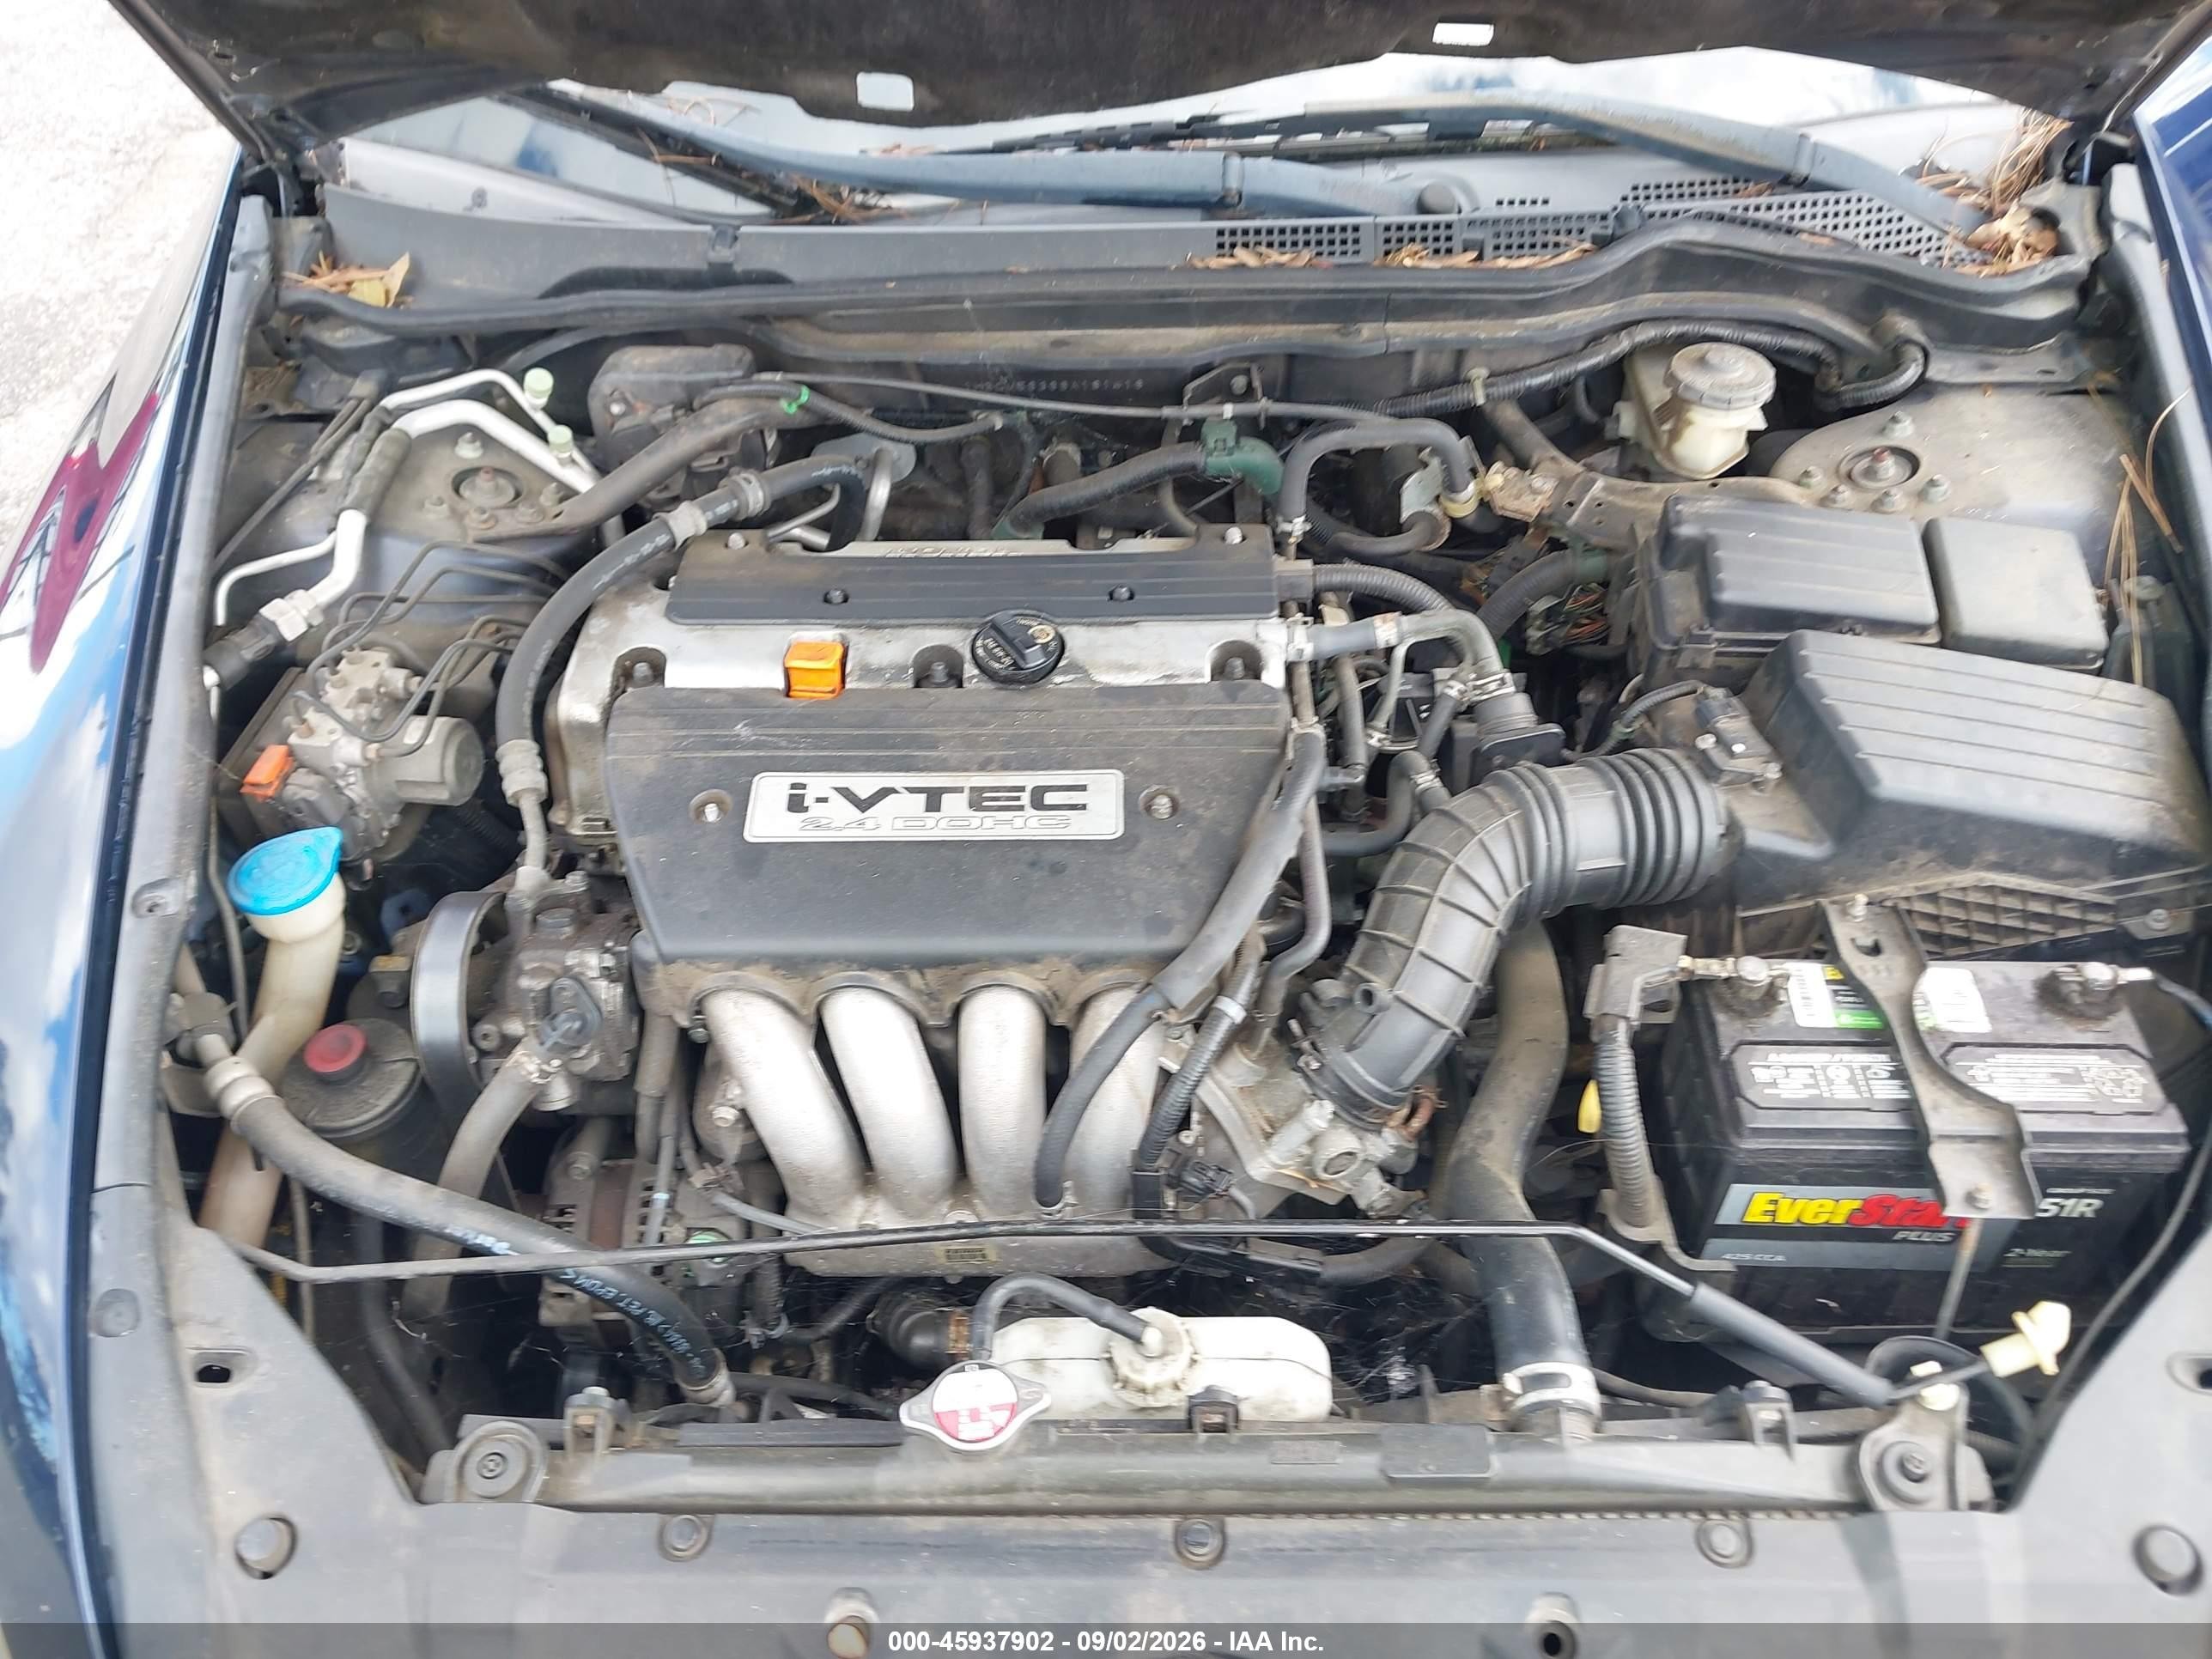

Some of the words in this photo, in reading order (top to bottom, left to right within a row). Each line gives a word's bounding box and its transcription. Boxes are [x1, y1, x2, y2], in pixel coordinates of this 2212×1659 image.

[787, 782, 1087, 813] i-VTEC
[891, 815, 1073, 830] DOHC
[1741, 1191, 1970, 1229] EverSta
[2035, 1198, 2104, 1218] 51R
[1893, 1231, 1956, 1243] PLUS
